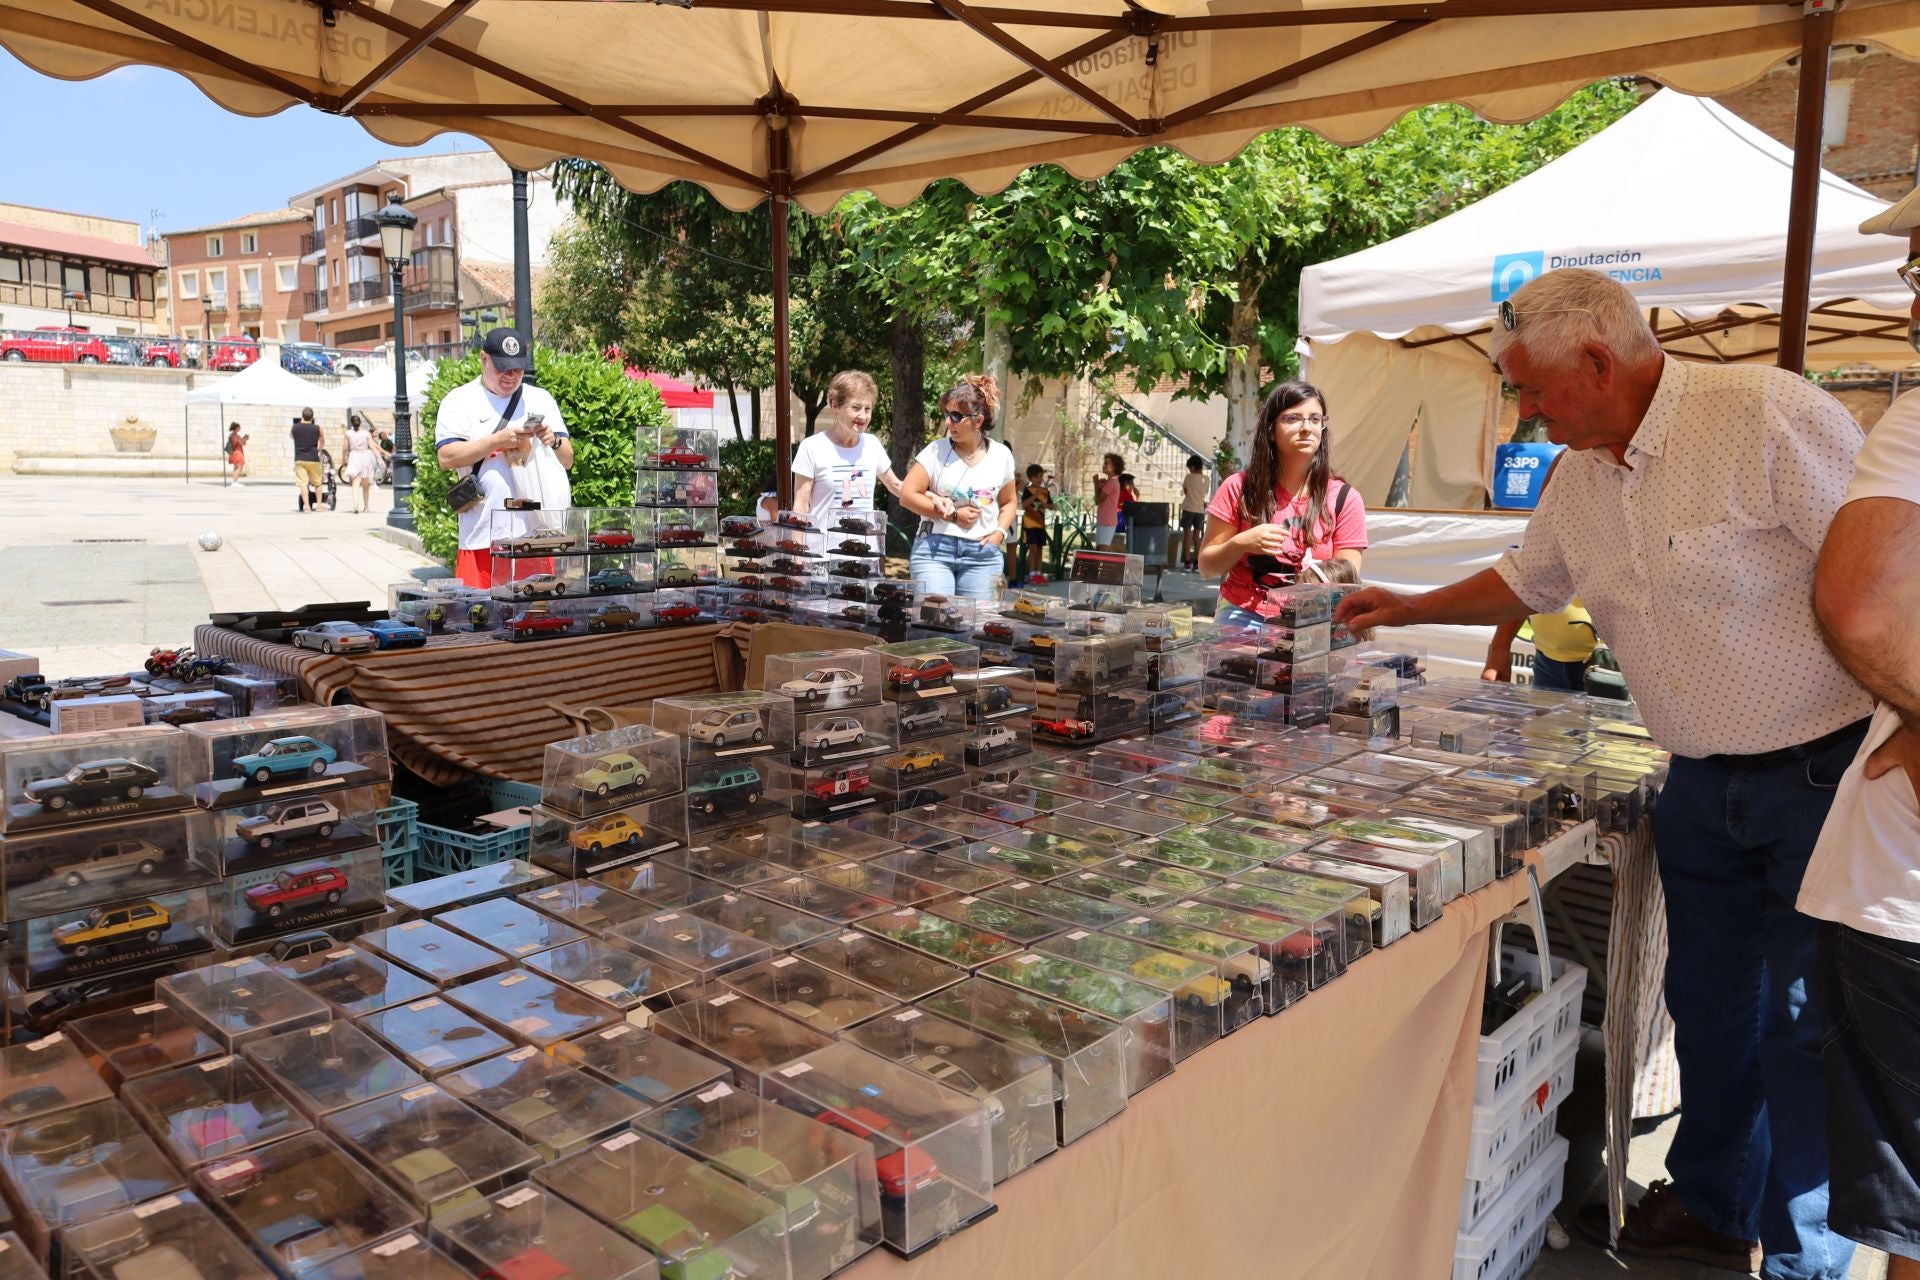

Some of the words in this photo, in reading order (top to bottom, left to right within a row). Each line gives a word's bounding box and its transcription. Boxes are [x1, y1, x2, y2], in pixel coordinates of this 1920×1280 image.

[1550, 249, 1642, 269] Diputación
[1609, 267, 1663, 283] ENCIA
[1503, 456, 1540, 469] 33P9
[66, 808, 94, 817] SEAT
[297, 911, 325, 923] PANDA
[66, 962, 94, 973] SEAT
[94, 949, 151, 969] MARBELLA
